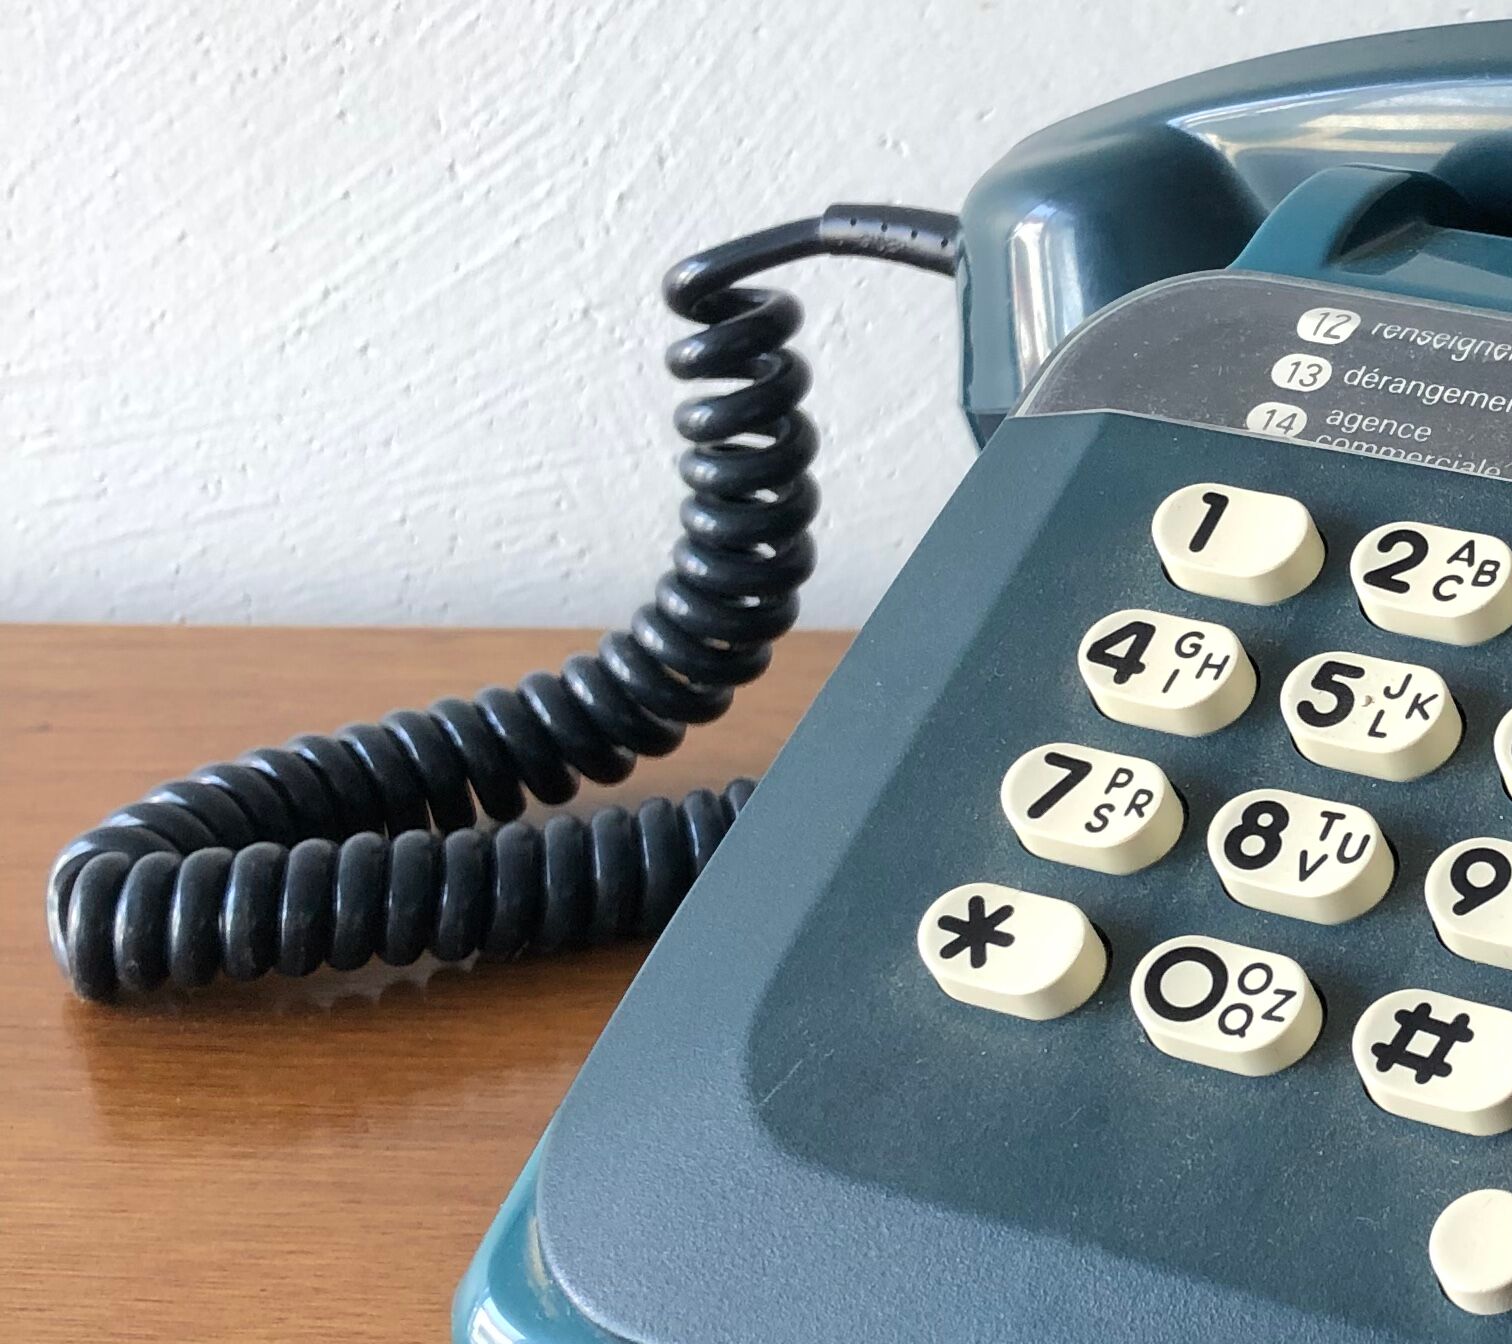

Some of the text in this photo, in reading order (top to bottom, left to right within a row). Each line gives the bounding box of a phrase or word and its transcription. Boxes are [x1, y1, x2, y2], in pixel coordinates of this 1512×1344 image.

[1311, 311, 1352, 341] 12
[1286, 359, 1324, 388] 13
[1261, 407, 1433, 443] 14 agence
[1189, 493, 1228, 552] 1
[1363, 528, 1428, 593] 2
[1084, 619, 1155, 684] 4
[1294, 659, 1365, 727] 5
[1028, 752, 1092, 818] 7
[1224, 801, 1289, 870] 8
[1450, 848, 1511, 915] 9
